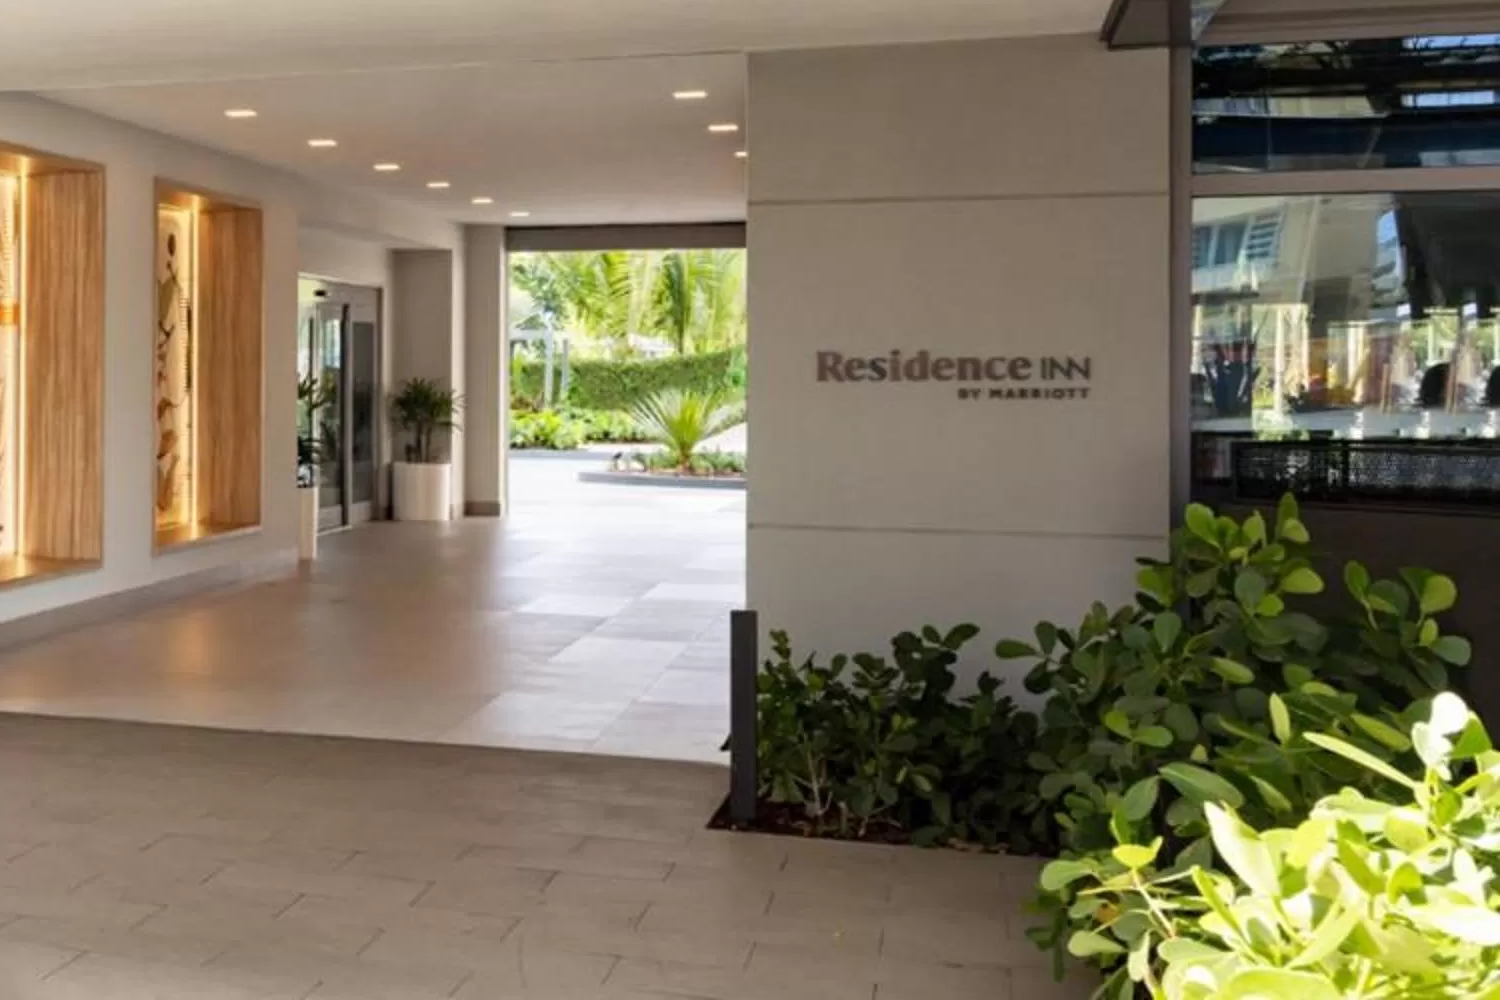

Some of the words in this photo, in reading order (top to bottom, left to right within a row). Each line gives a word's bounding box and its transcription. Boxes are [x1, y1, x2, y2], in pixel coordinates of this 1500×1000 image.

[816, 349, 1032, 382] Residence
[1040, 356, 1092, 381] INN
[957, 387, 981, 400] BY
[988, 387, 1091, 401] MARRIOTT
